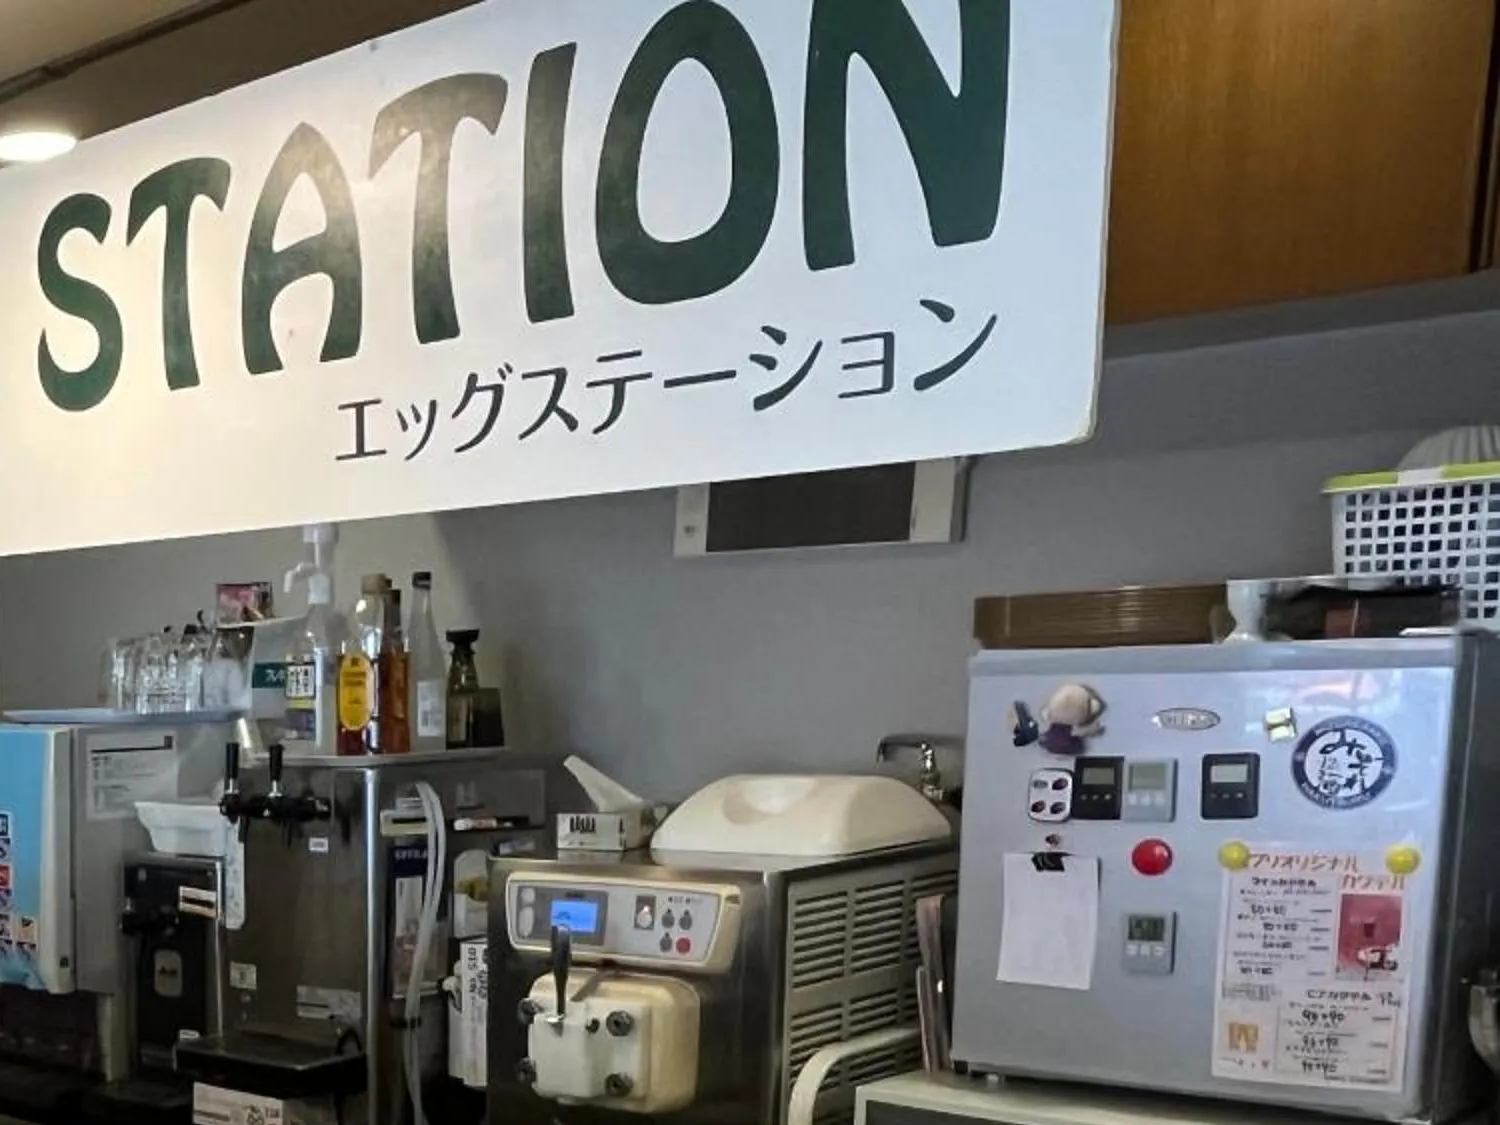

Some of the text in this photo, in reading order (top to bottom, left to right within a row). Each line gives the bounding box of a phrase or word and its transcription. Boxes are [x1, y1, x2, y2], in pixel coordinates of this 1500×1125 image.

[36, 0, 1011, 413] STATION
[333, 298, 1001, 461] エッグステーション
